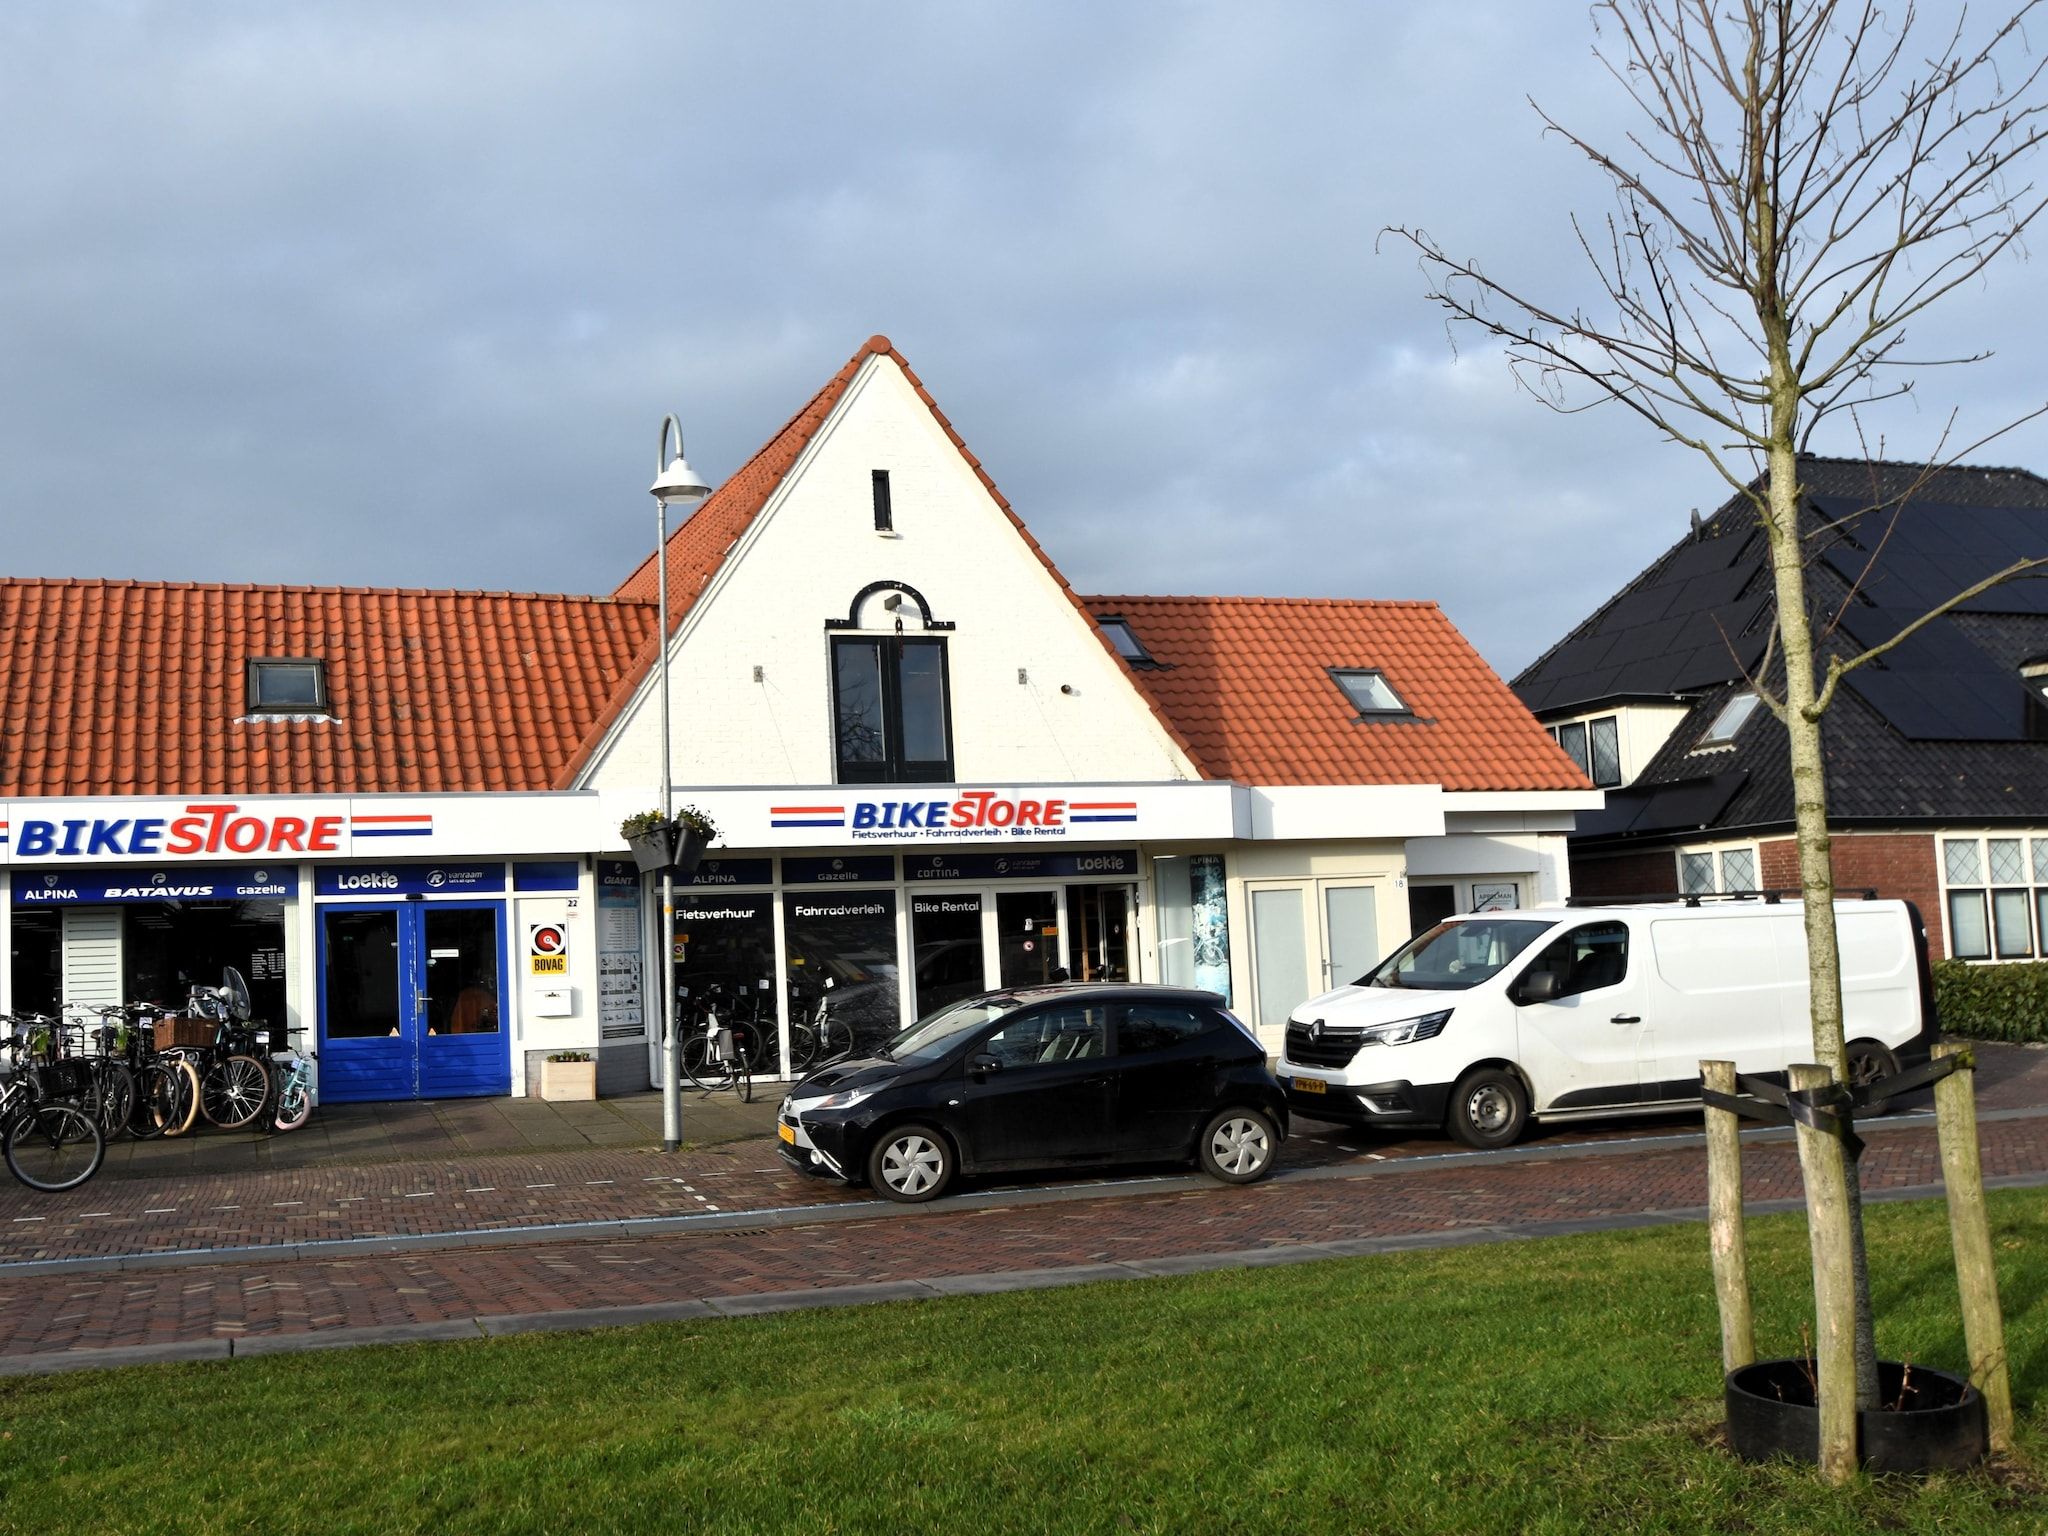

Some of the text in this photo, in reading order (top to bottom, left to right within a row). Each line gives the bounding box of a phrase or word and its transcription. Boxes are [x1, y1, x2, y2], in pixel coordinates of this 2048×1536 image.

[852, 791, 1065, 829] BIKESTORE
[16, 804, 344, 857] BIKESTORE
[852, 827, 1066, 839] Fietsverhuur Fahrradverleih Bike Rental
[604, 876, 633, 885] GIANT
[693, 874, 737, 885] ALPINA
[817, 872, 859, 881] Gazelle
[25, 889, 78, 900] ALPINA
[104, 886, 213, 898] BATAVUS
[236, 884, 286, 895] Gazelle
[567, 899, 578, 907] 22
[914, 901, 979, 913] Bike Rental
[675, 909, 755, 920] Fietsverhuur
[795, 904, 885, 917] Fahrradverleih
[534, 958, 563, 971] BOVAG
